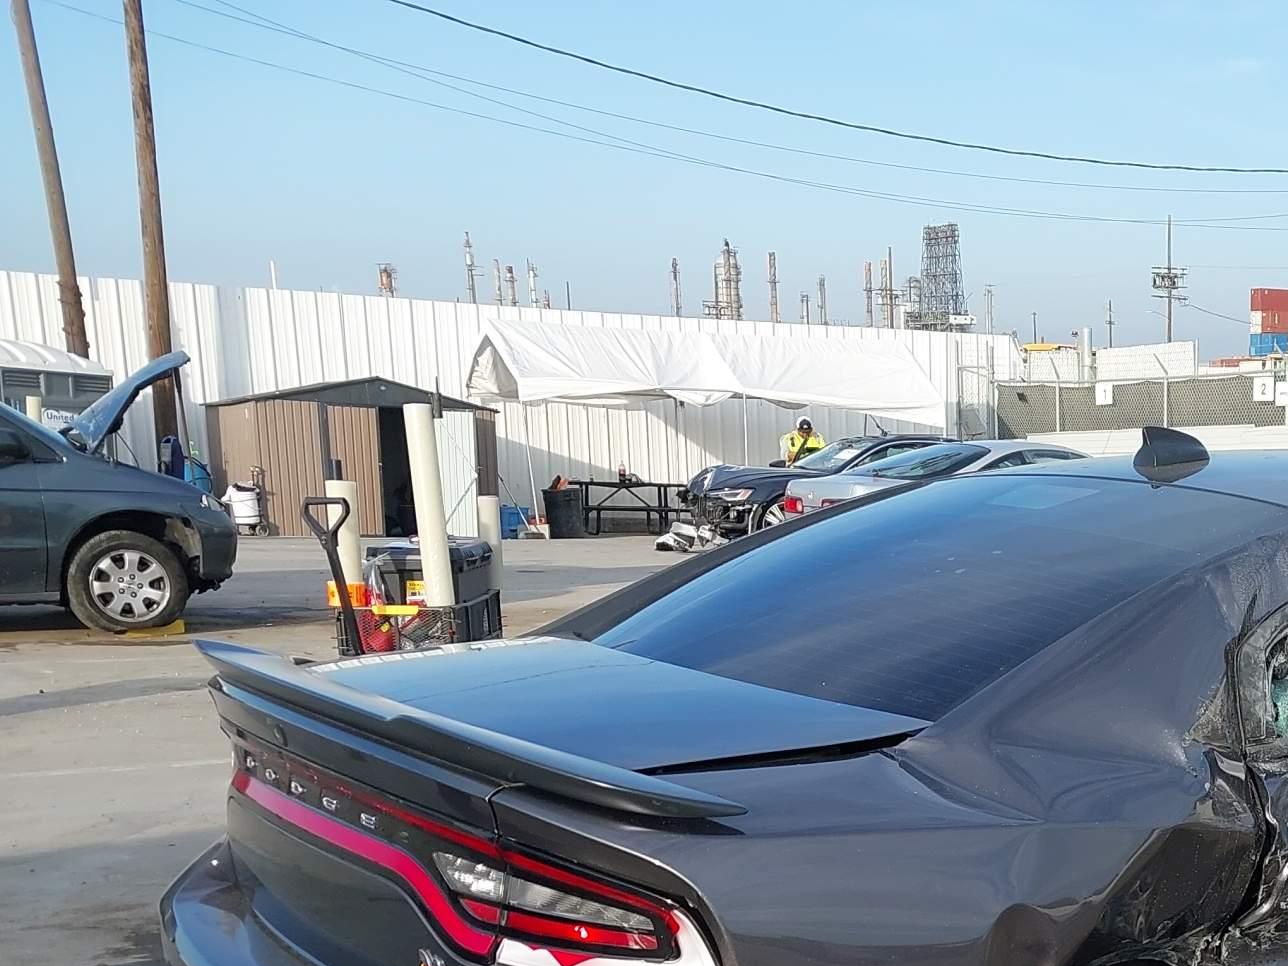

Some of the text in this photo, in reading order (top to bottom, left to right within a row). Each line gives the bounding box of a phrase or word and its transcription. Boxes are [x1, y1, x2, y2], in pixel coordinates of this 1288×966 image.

[1261, 383, 1267, 395] 2
[46, 411, 75, 421] United
[246, 756, 377, 830] DODGE
